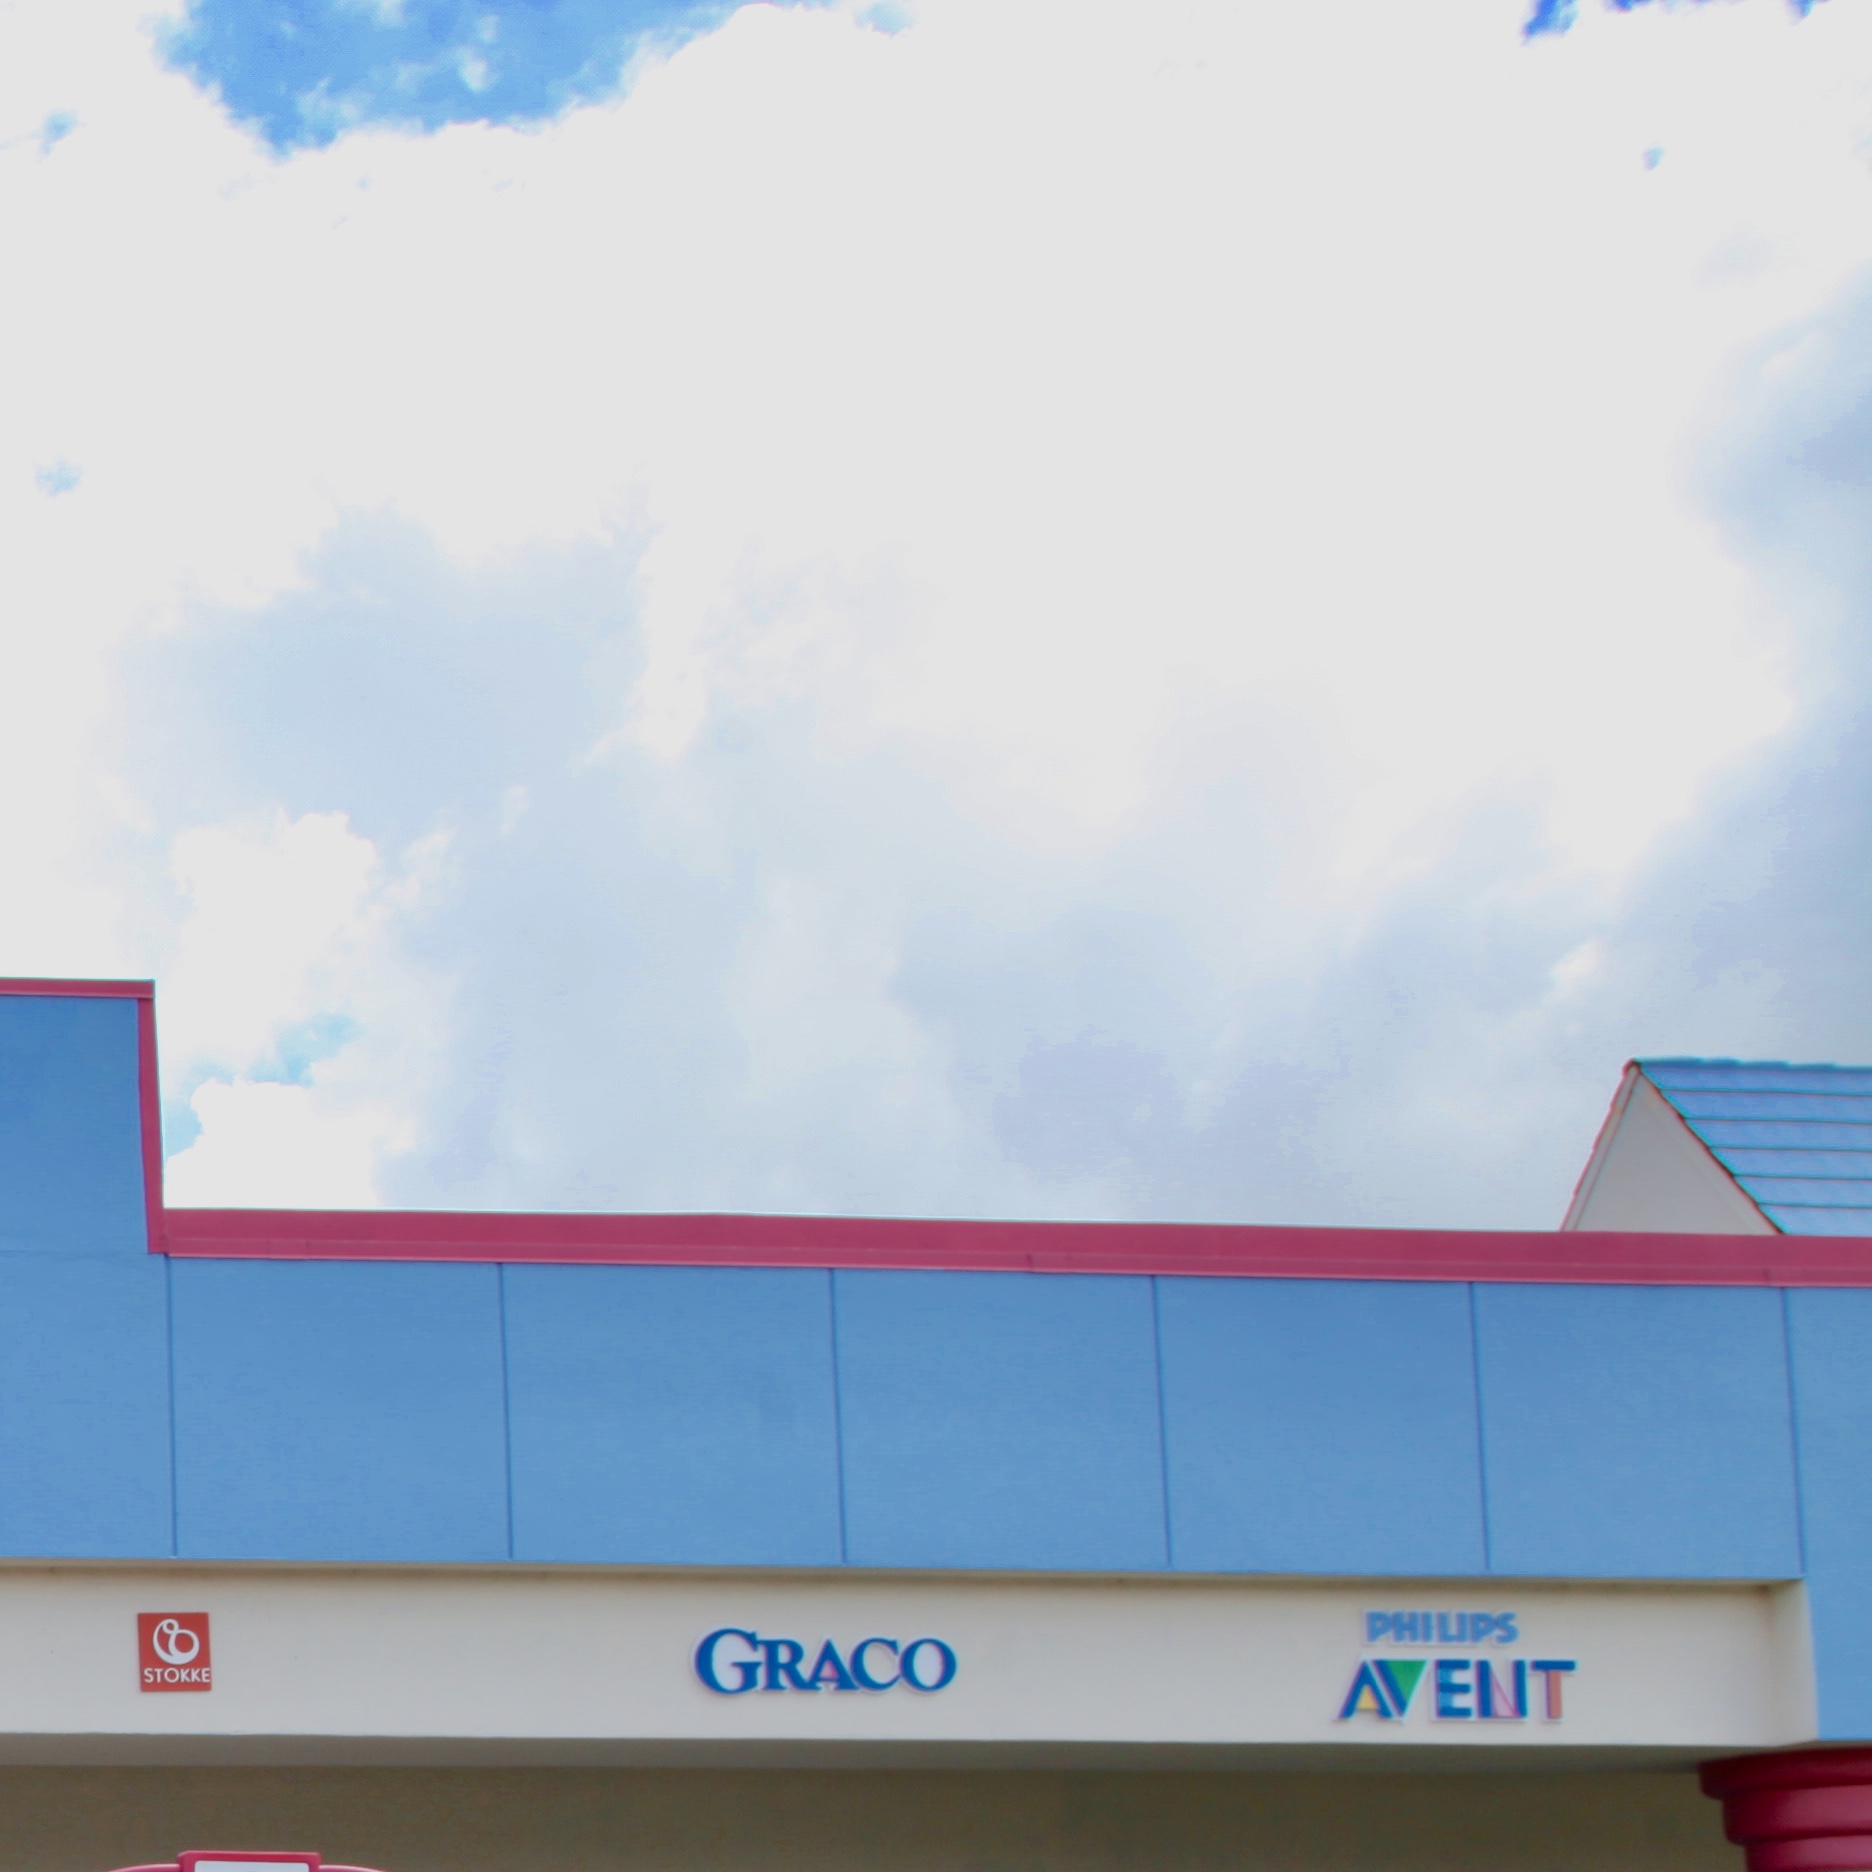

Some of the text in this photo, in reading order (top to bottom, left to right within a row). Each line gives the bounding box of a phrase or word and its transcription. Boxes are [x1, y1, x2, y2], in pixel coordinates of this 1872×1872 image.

[1365, 1610, 1520, 1645] PHILIPS
[143, 1667, 211, 1683] STOKKE
[1337, 1658, 1577, 1719] AVENT
